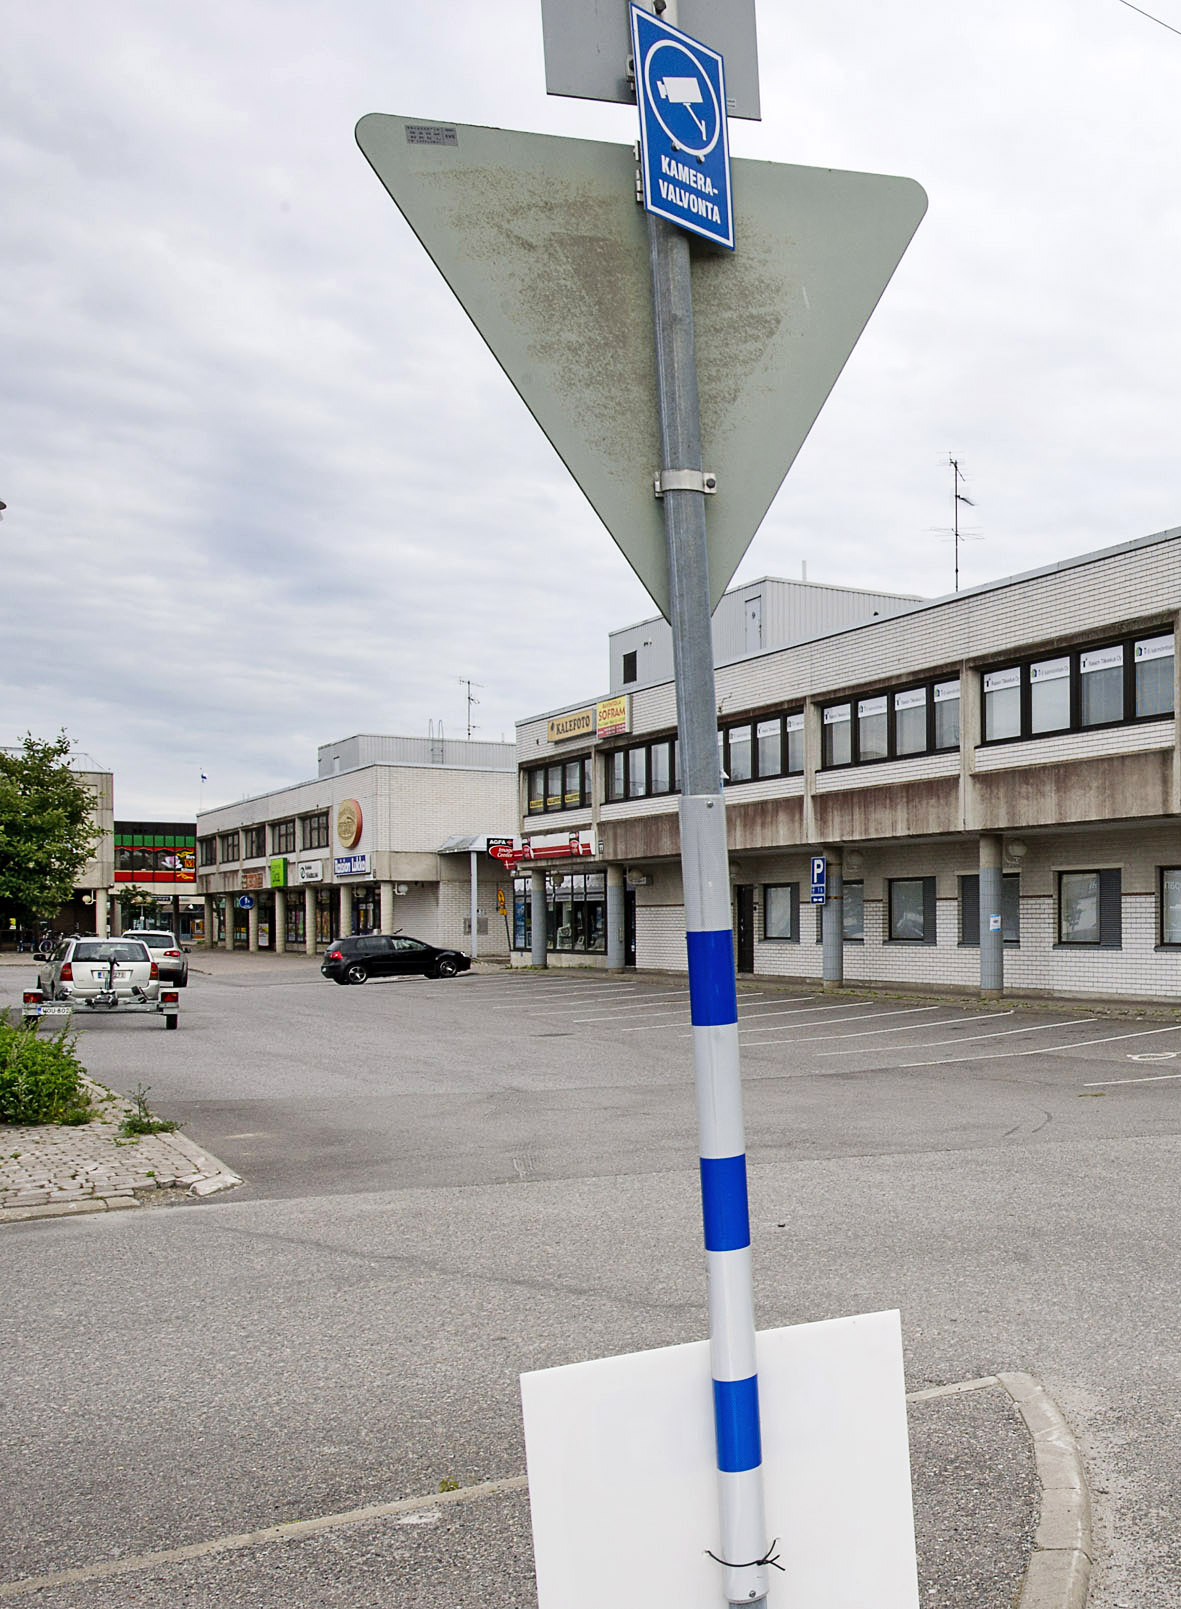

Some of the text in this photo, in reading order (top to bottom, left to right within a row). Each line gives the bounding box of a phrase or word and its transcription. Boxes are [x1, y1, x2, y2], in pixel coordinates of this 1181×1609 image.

[661, 154, 719, 197] KAMERA-
[658, 178, 721, 225] VALVONTA
[556, 715, 591, 736] KALEFOTO
[598, 706, 626, 722] SOFRAM
[813, 859, 824, 883] P
